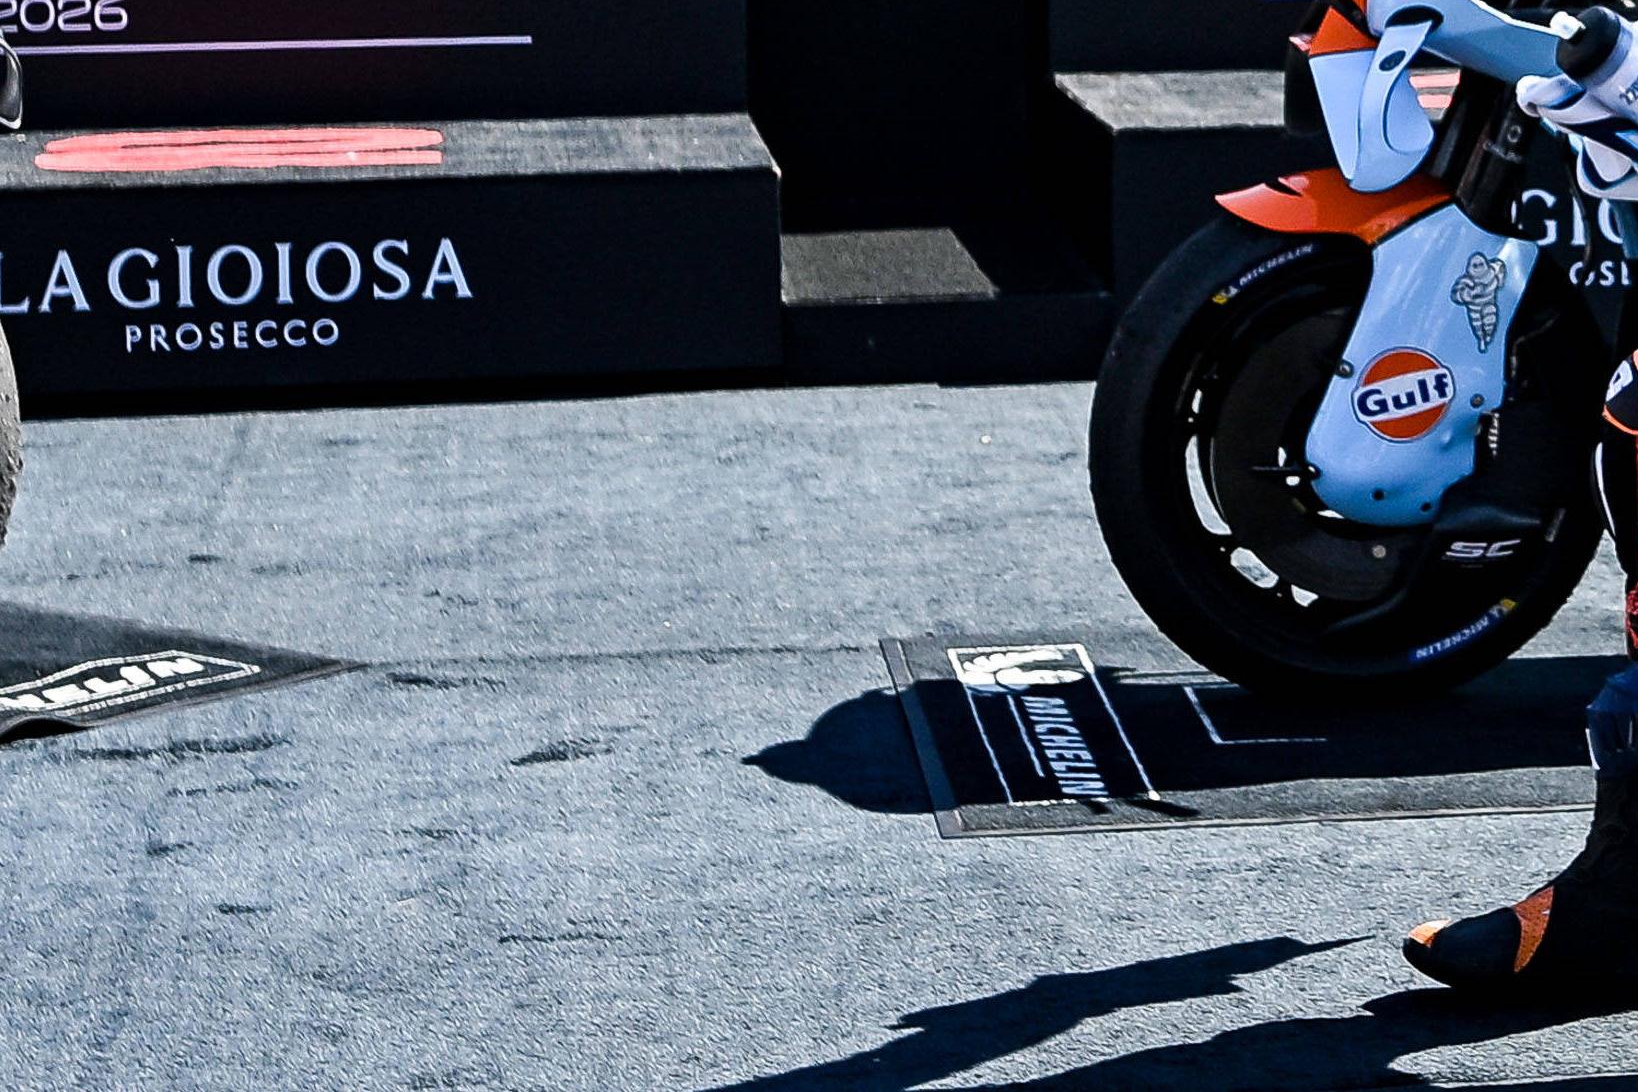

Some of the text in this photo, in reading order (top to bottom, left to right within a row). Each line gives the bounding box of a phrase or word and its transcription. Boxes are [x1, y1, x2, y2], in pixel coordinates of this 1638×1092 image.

[107, 238, 473, 309] GIOIOSA
[125, 318, 339, 353] PROSECCO
[1357, 373, 1449, 417] Gulf
[1445, 539, 1521, 558] SC
[1415, 616, 1489, 659] MICHELIN
[1020, 695, 1109, 797] MICHELIN
